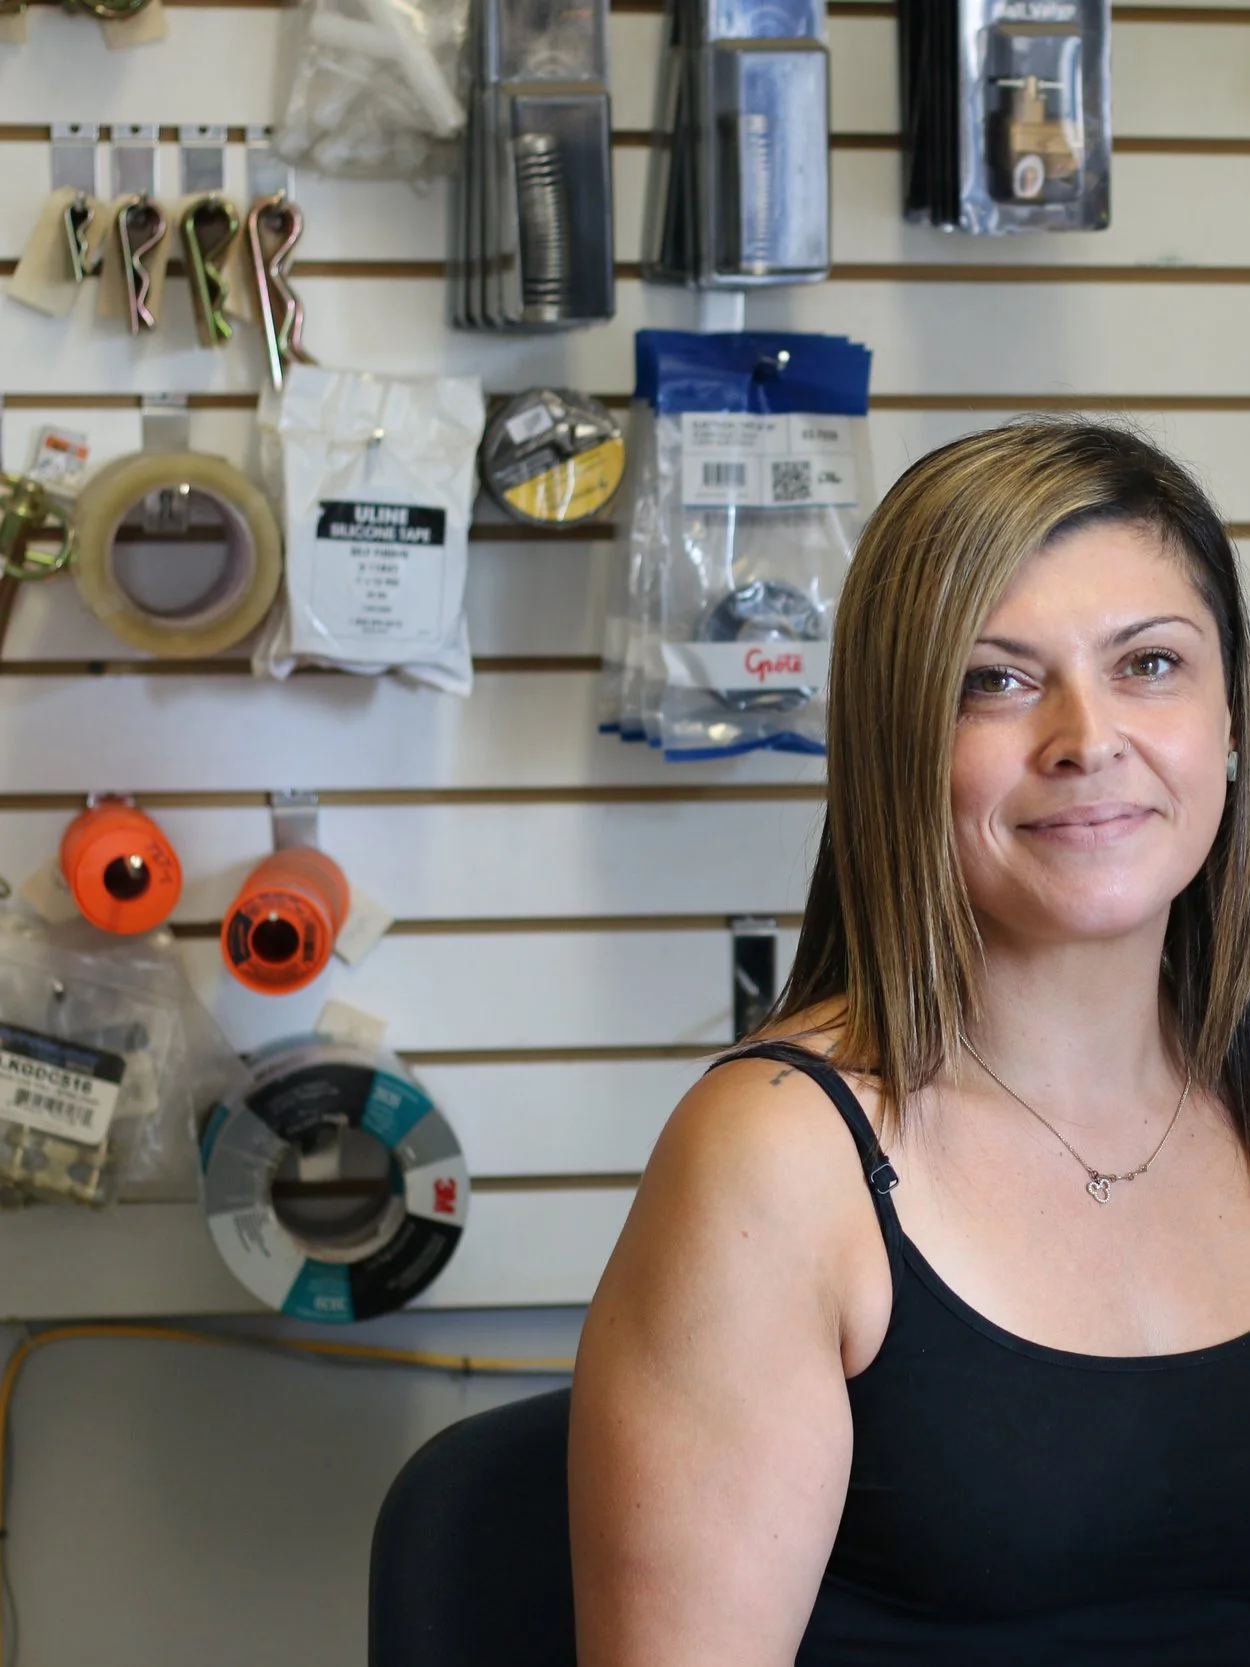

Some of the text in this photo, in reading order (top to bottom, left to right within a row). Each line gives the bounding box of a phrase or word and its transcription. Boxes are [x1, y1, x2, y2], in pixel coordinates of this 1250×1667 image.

[354, 505, 409, 525] ULINE
[329, 522, 431, 543] SILICONE TAPE
[744, 648, 803, 682] Grote
[433, 1177, 457, 1216] 3M
